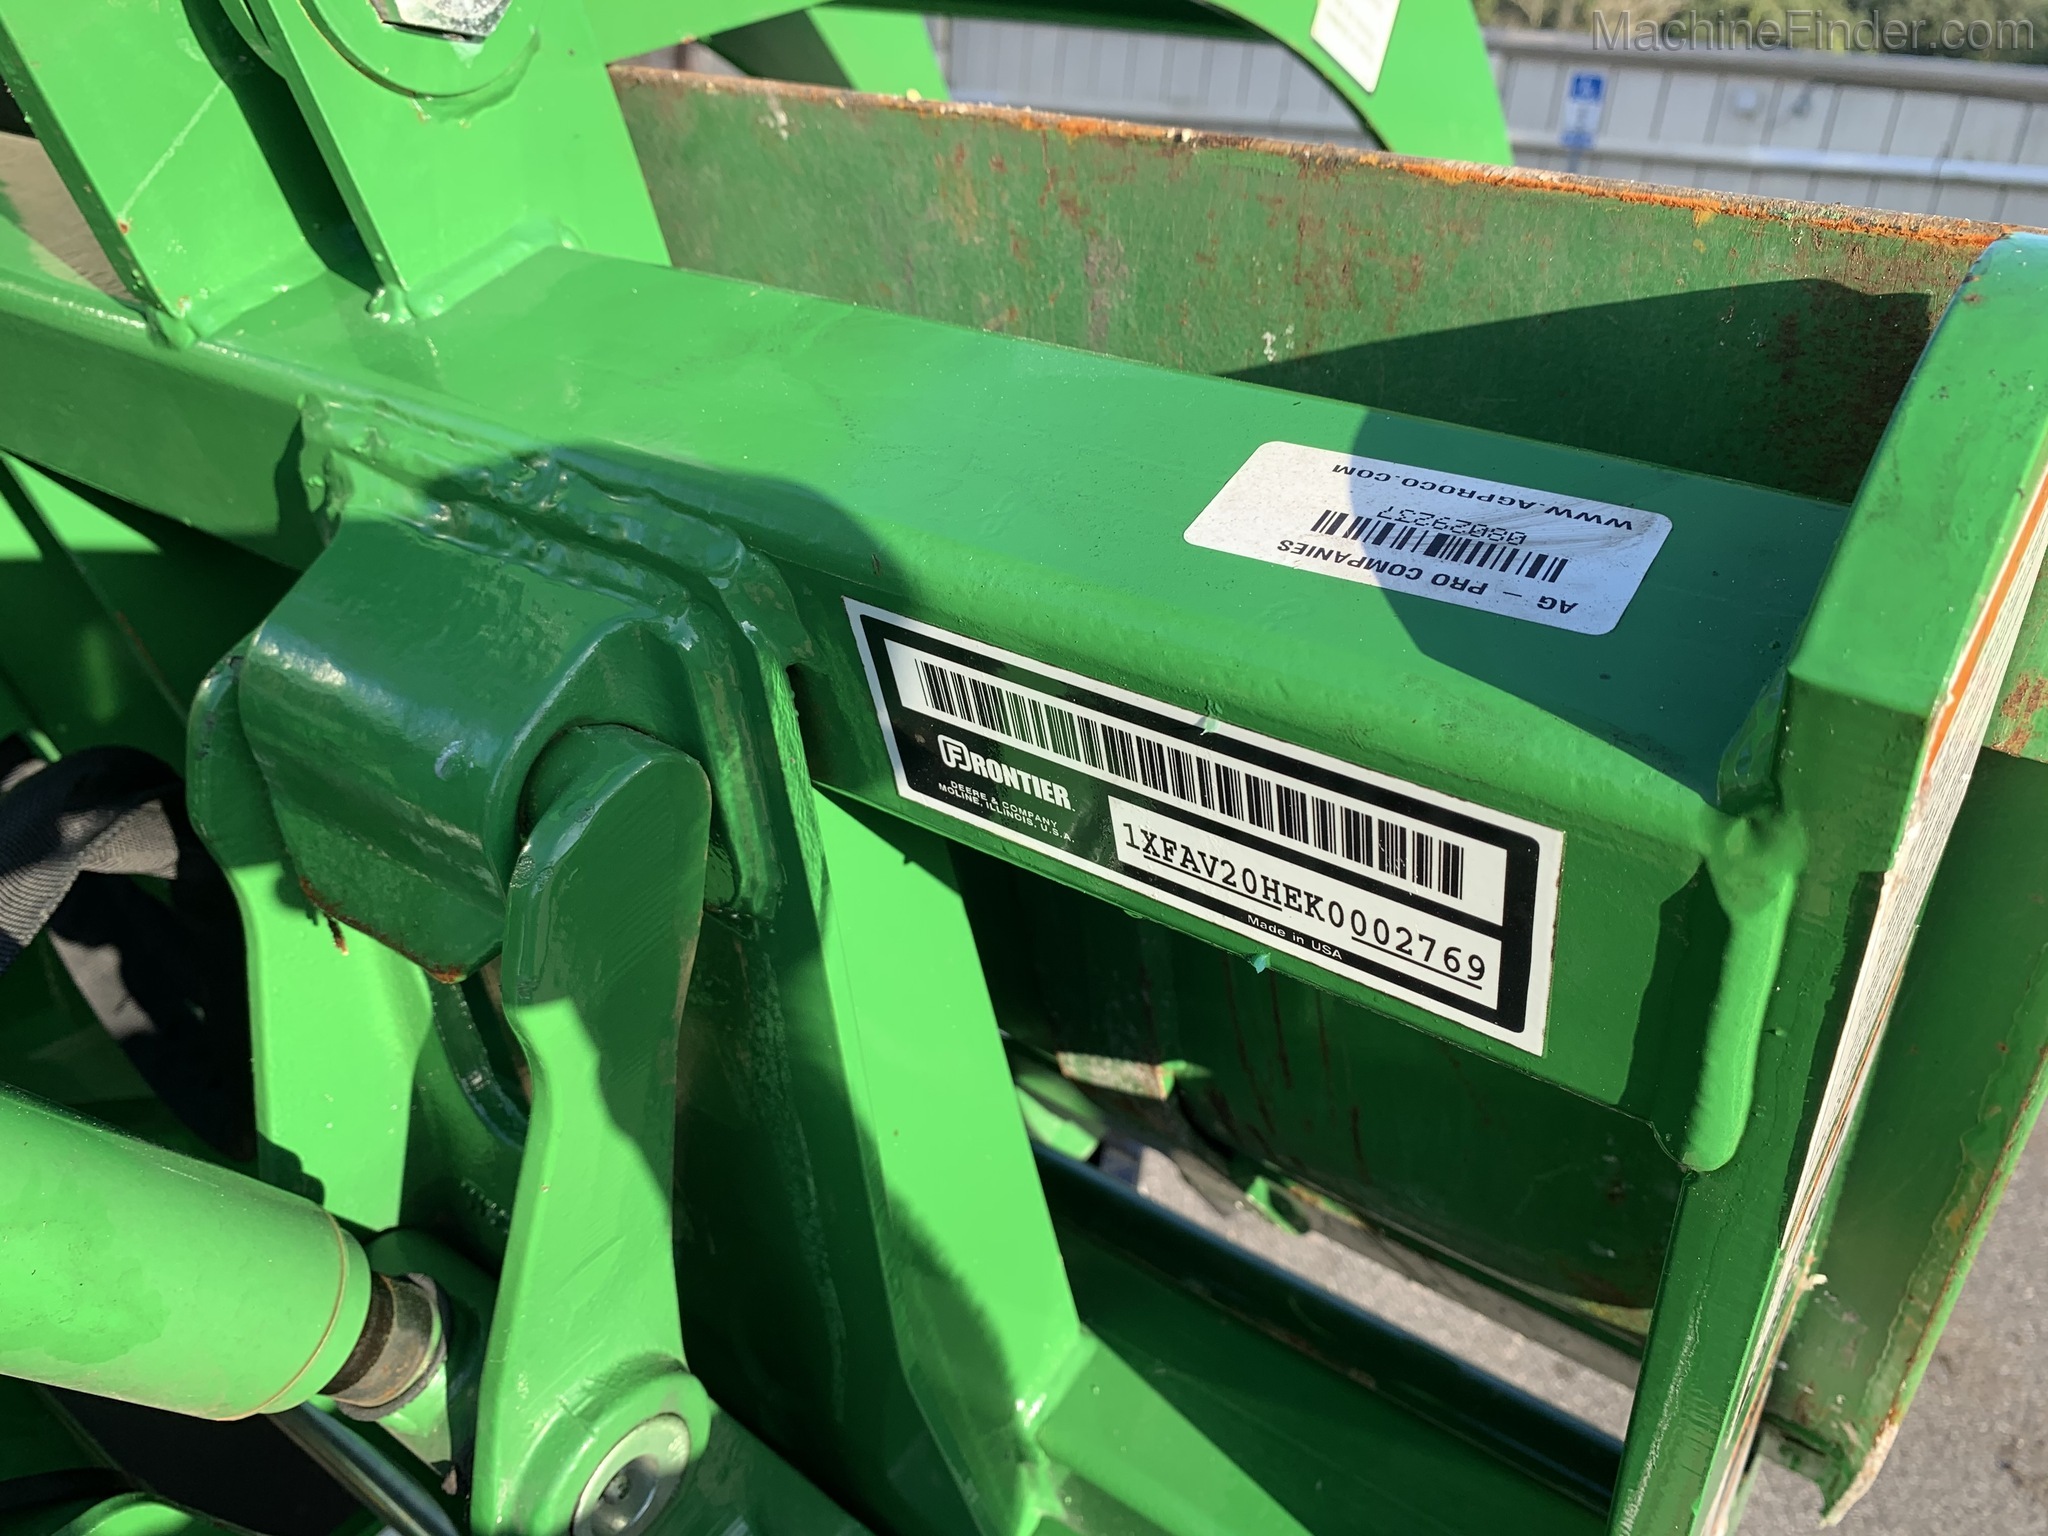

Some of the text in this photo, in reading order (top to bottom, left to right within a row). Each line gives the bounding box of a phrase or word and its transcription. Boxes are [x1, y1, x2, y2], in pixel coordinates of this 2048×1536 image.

[1331, 464, 1633, 531] WWW.AGPROCO.COM
[1376, 505, 1527, 545] 08029237
[1277, 539, 1420, 582] COMPANIES
[1432, 573, 1489, 596] PRO
[1538, 595, 1578, 614] AG
[937, 734, 1072, 810] FRONTIER
[950, 780, 1057, 828] DEERE & COMPANY
[1040, 824, 1075, 842] U.S.A.
[1123, 822, 1485, 981] 1XFAV20HEK0002769
[1247, 914, 1343, 960] Made in USA
